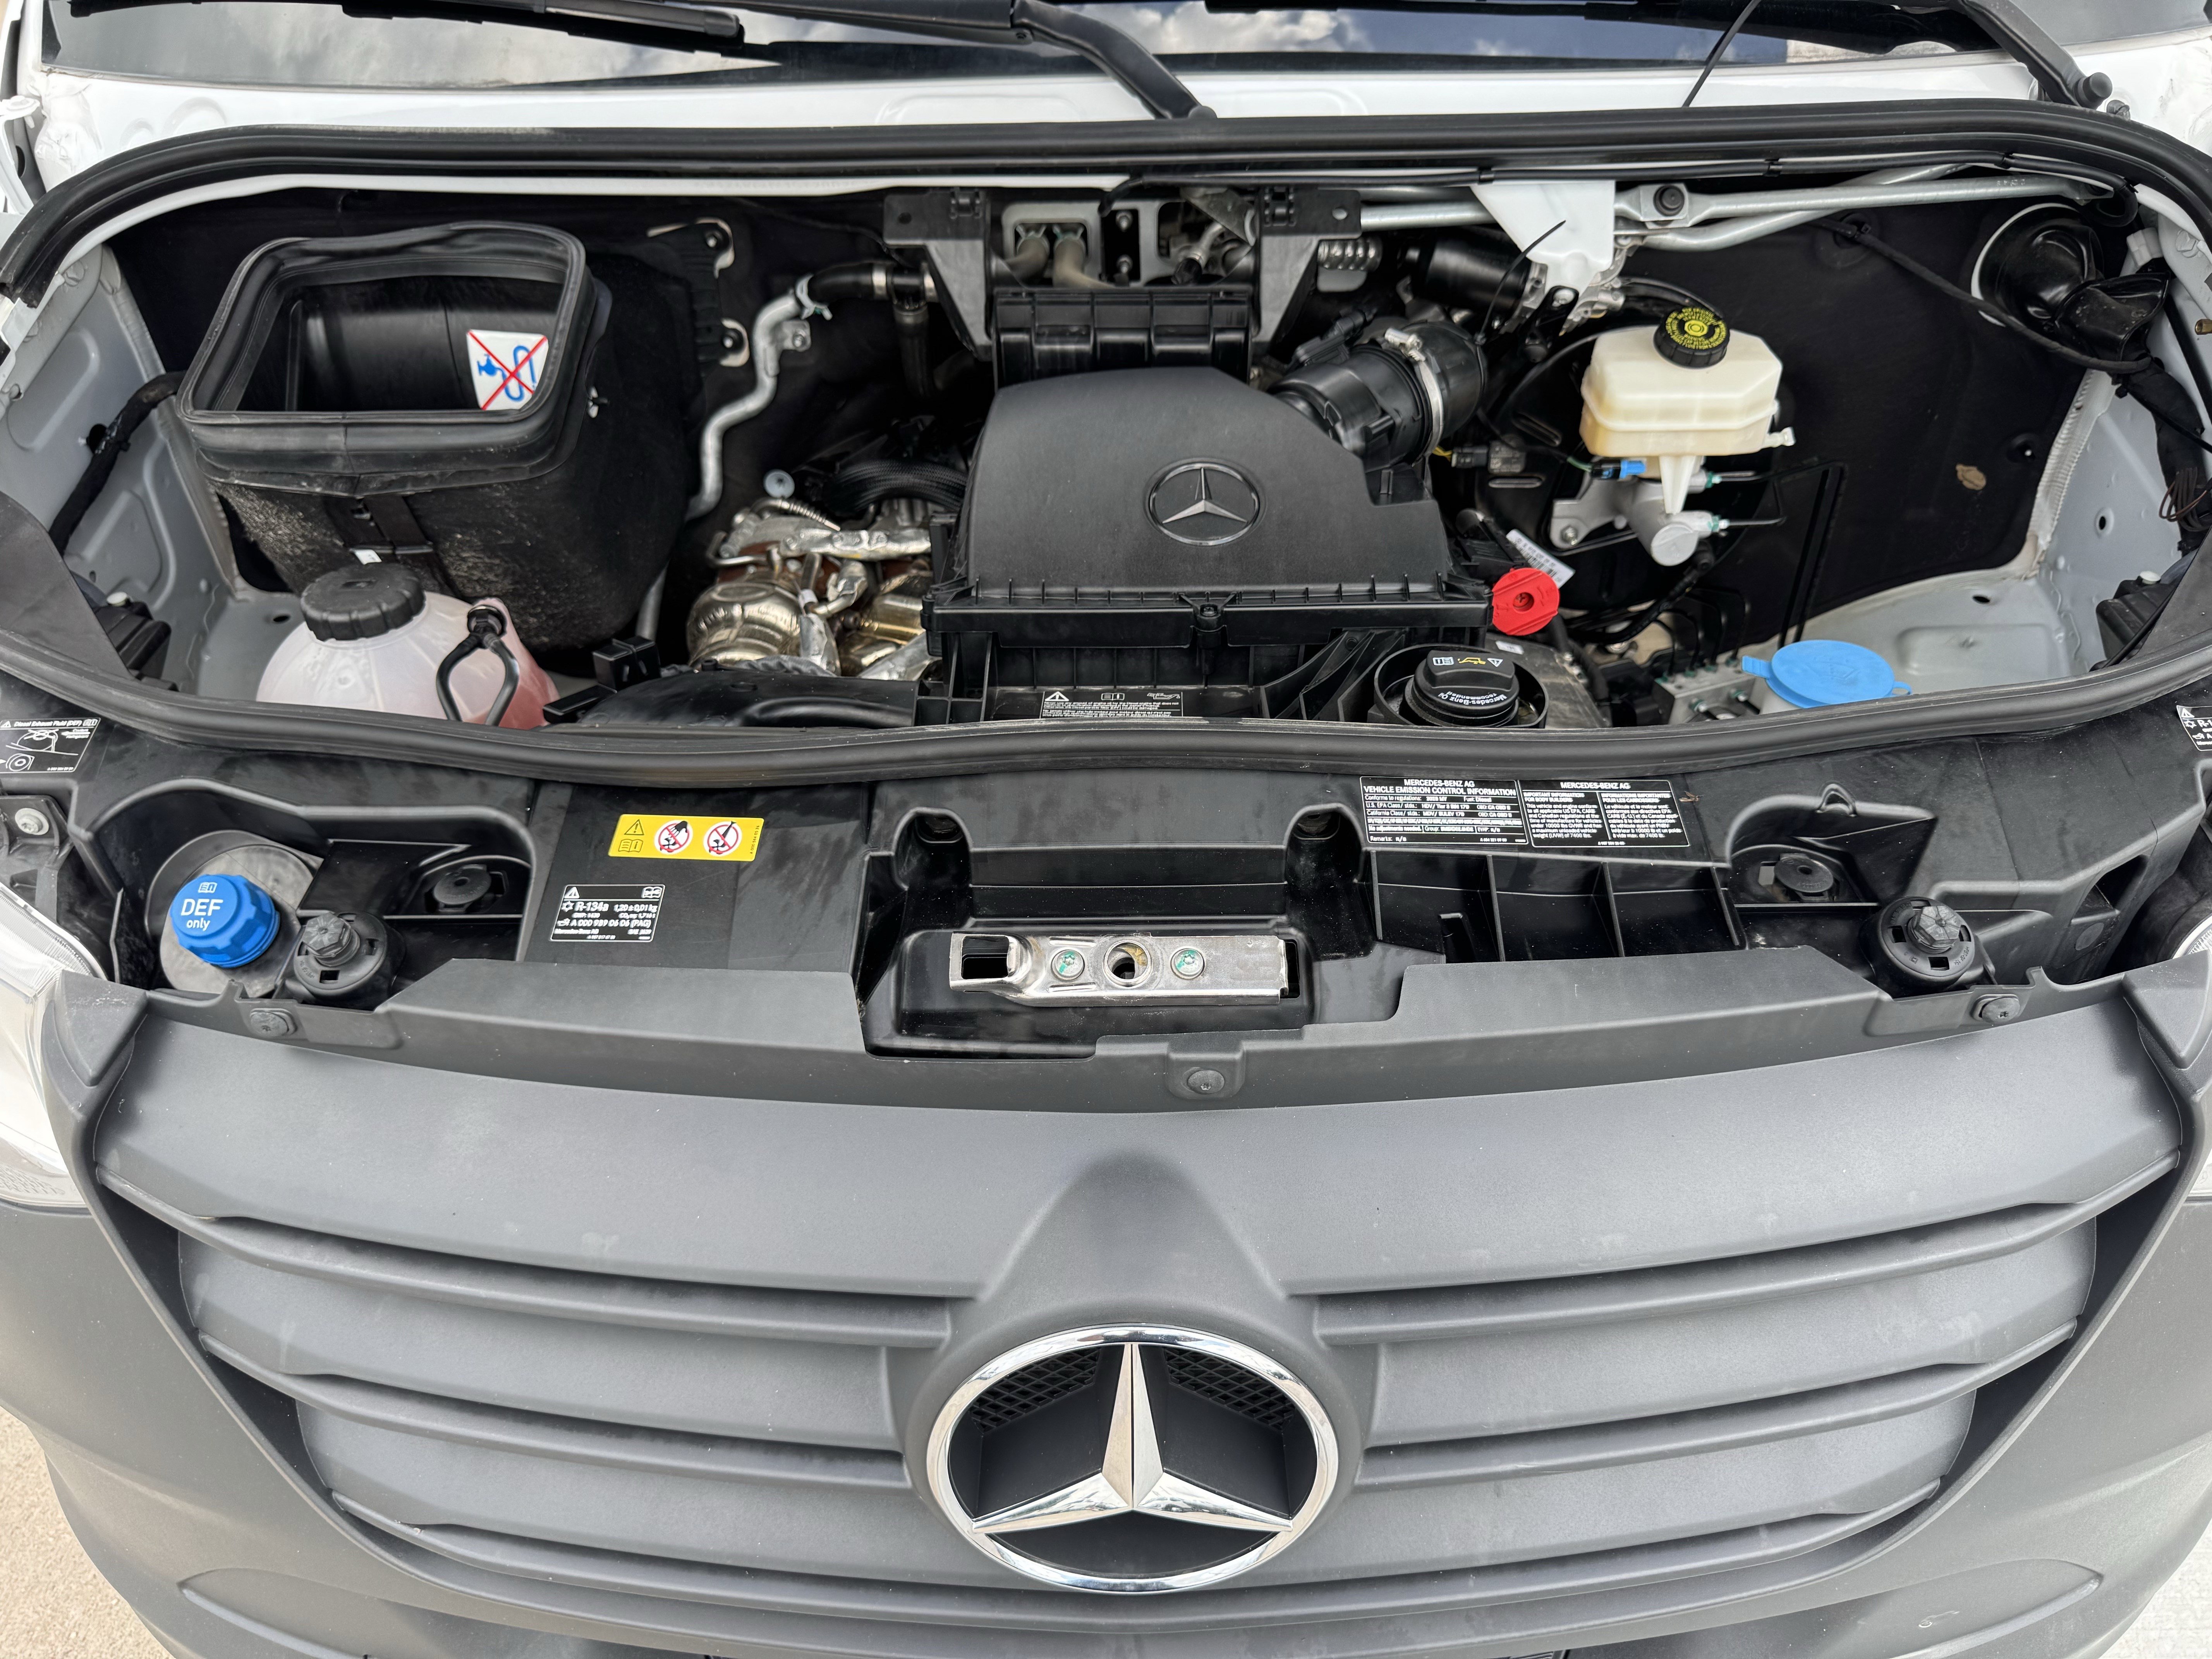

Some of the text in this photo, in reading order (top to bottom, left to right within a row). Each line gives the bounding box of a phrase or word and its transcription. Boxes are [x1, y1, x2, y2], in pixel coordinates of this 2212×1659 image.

[1404, 779, 1463, 787] MERCEDES-BENZ
[1467, 788, 1516, 796] INFORMATION
[181, 898, 223, 916] DEF
[574, 902, 609, 912] R-134a
[186, 917, 210, 931] only
[630, 919, 651, 928] (PAG)
